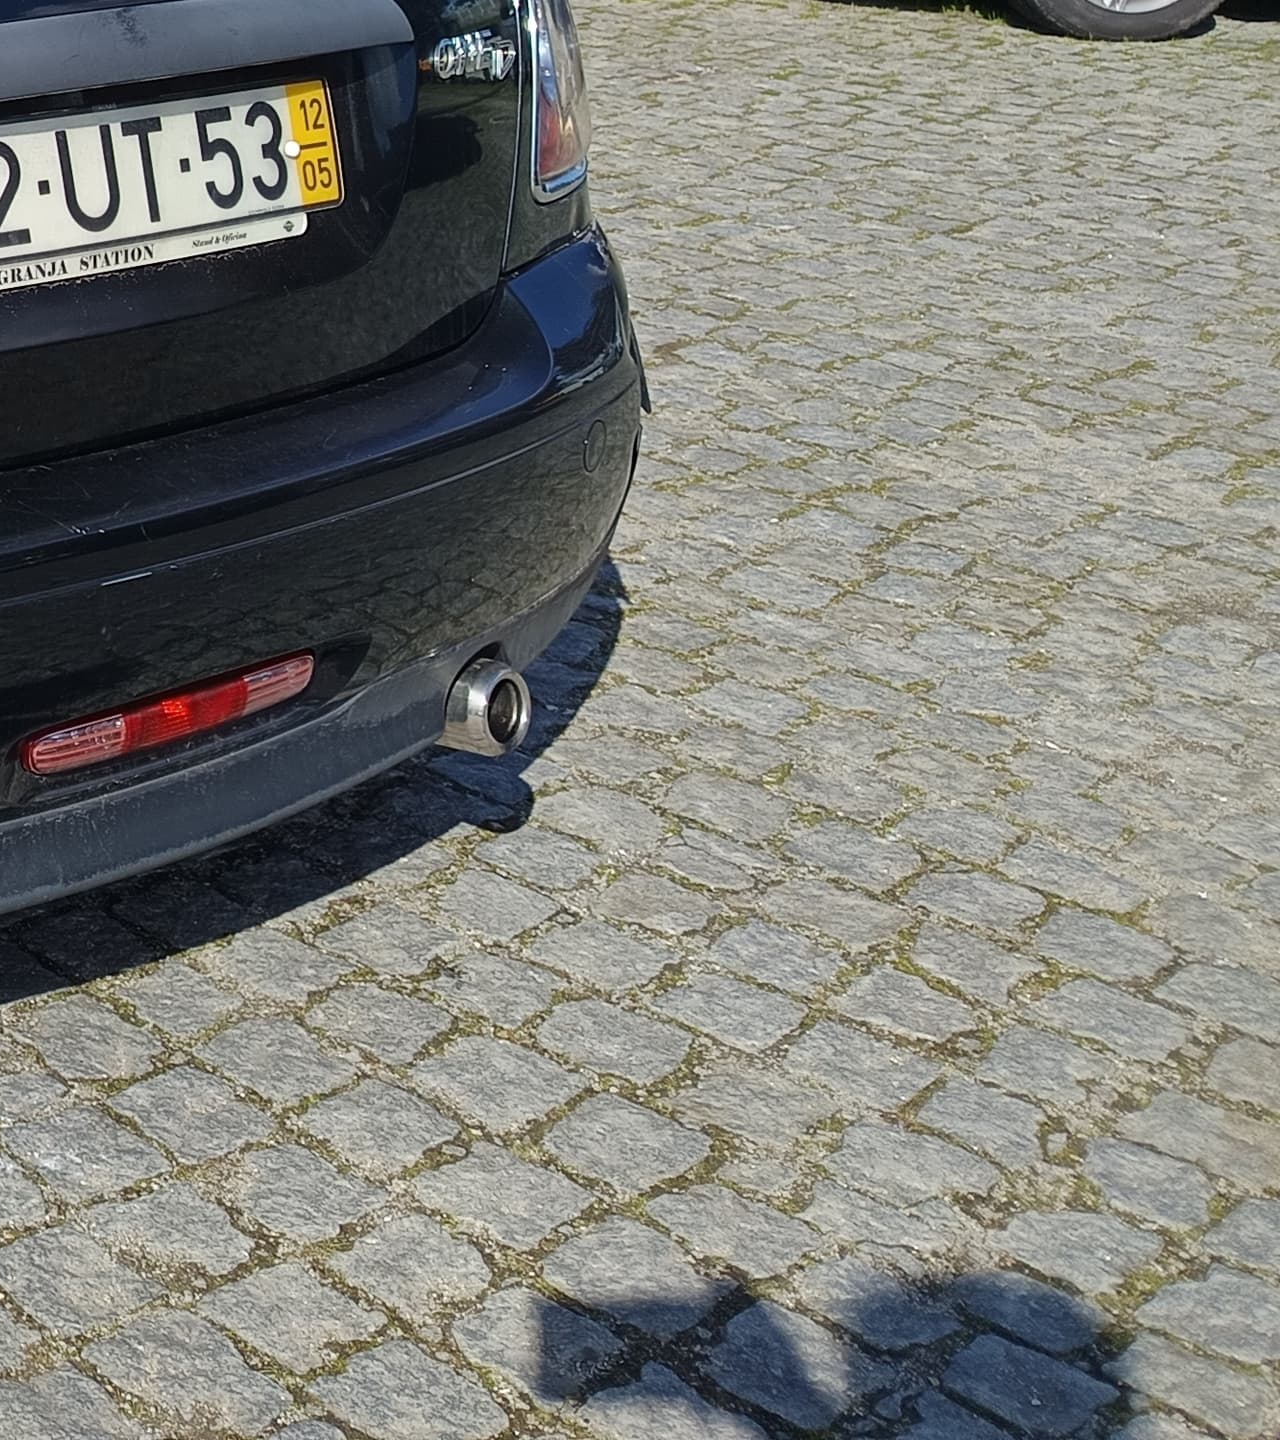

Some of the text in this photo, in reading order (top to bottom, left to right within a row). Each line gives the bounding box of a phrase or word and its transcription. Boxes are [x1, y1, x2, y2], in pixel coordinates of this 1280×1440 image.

[299, 98, 325, 132] 12
[302, 156, 333, 192] 05
[79, 244, 155, 271] STATION
